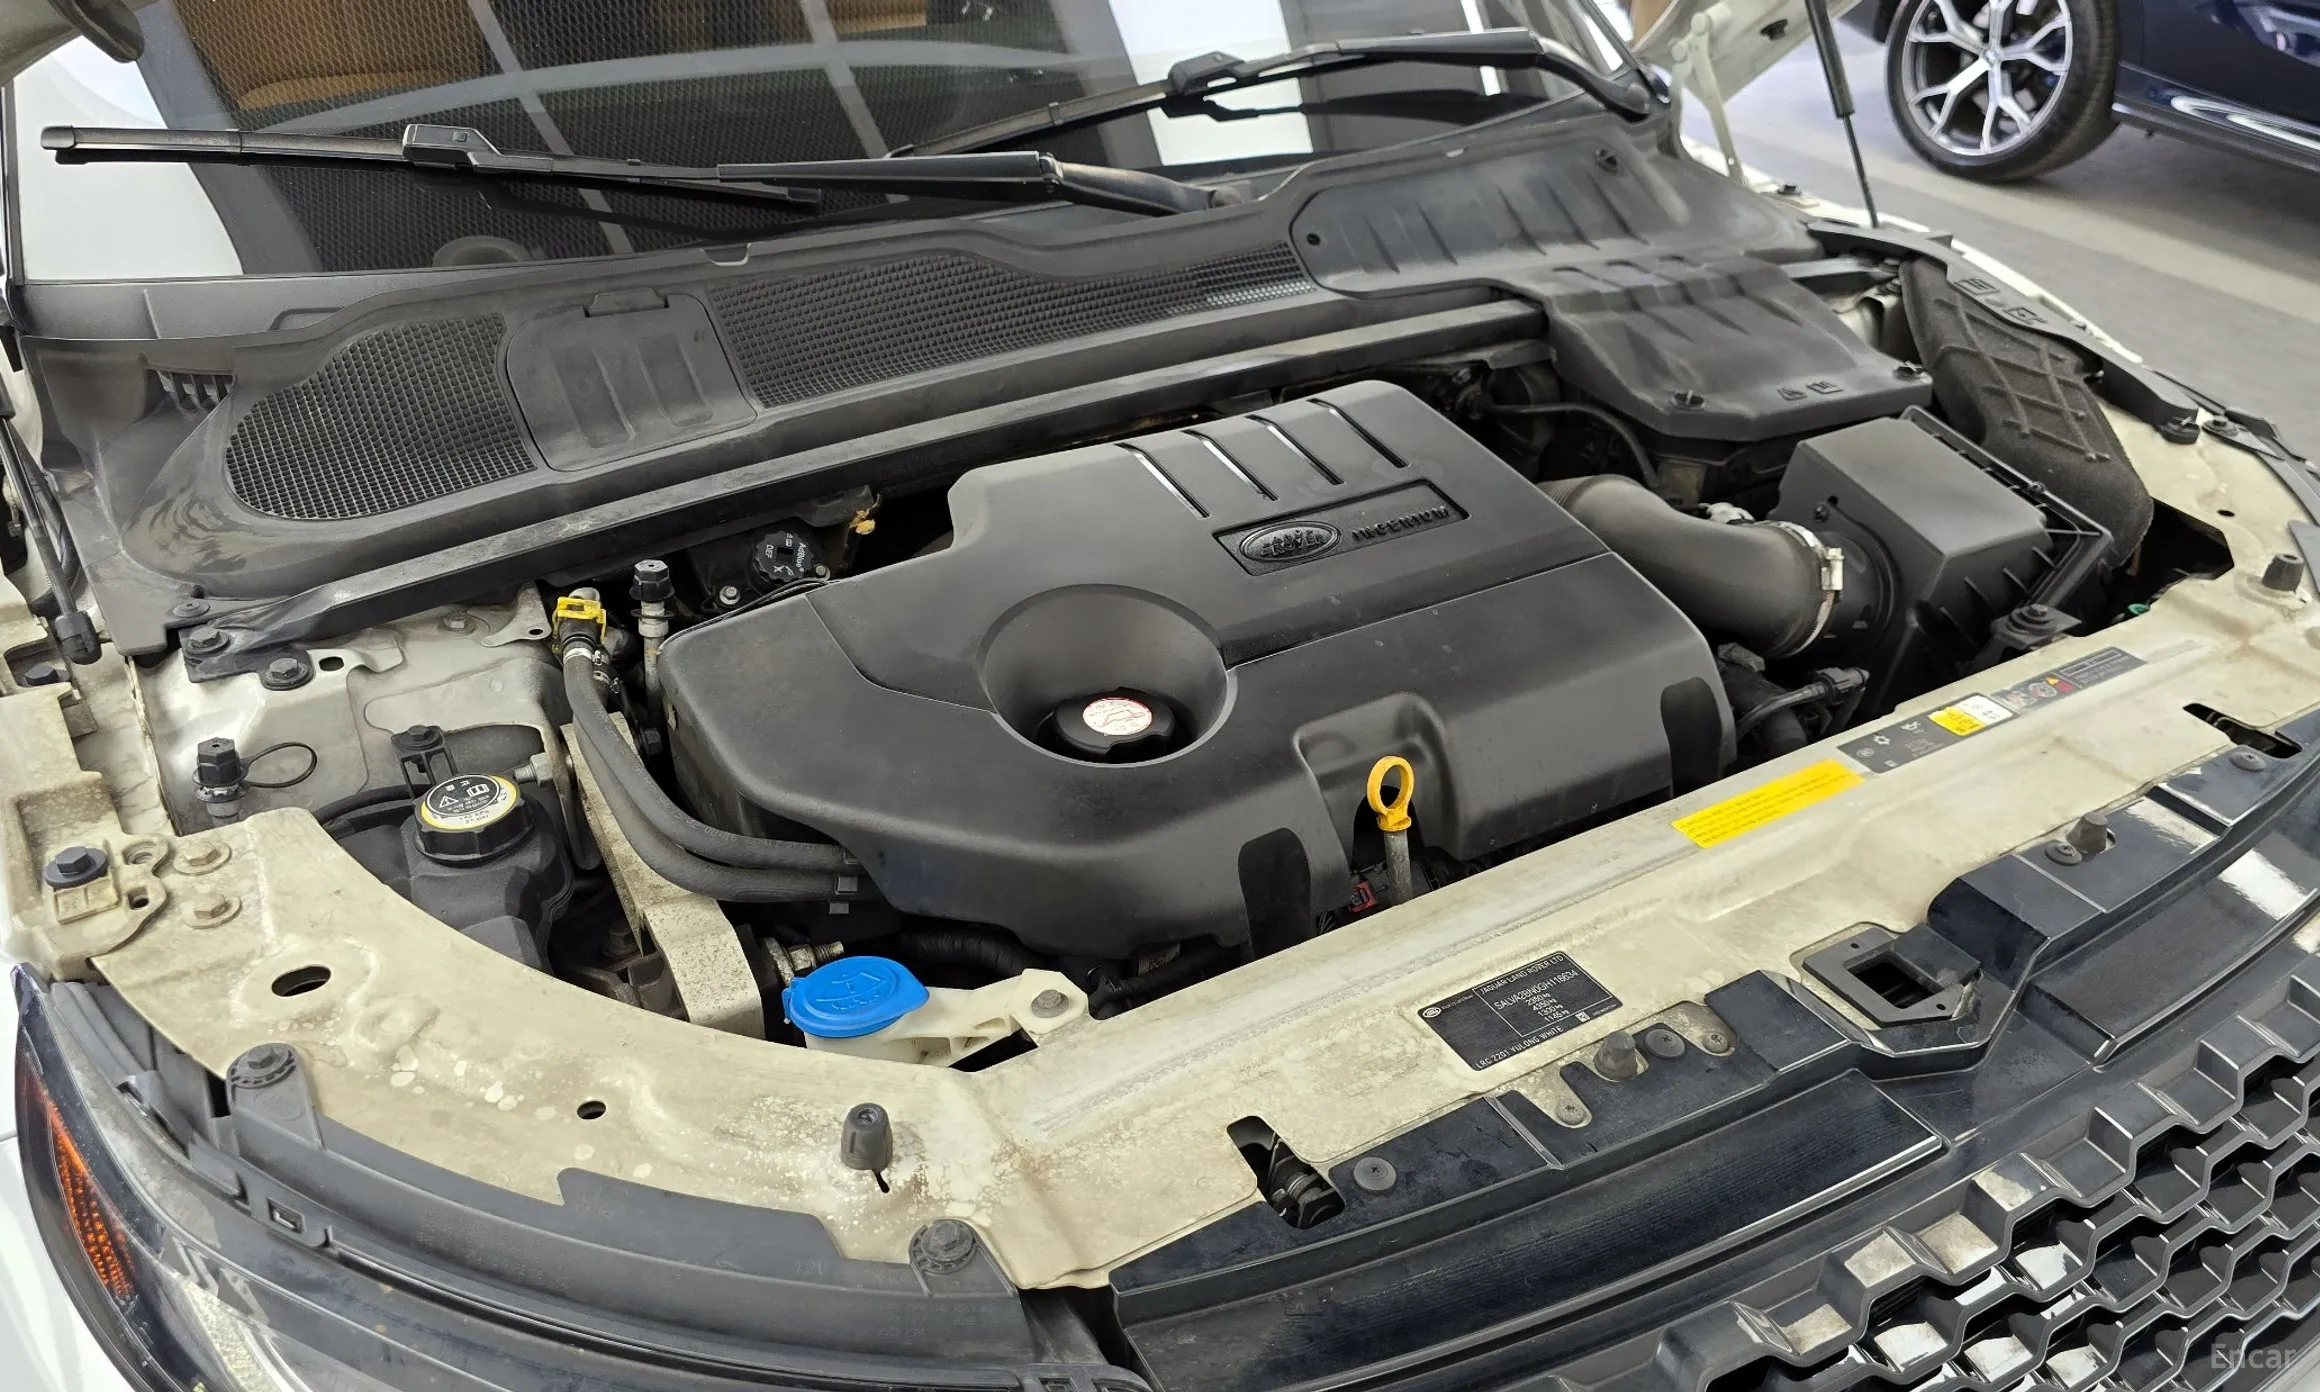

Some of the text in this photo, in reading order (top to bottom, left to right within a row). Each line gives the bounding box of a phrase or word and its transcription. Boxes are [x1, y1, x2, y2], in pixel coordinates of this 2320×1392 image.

[765, 544, 774, 559] DEF
[1480, 955, 1564, 995] JAGUAR LAND ROVER LTD
[1537, 1005, 1556, 1017] 1300
[1475, 1025, 1564, 1069] LRC 2201 YULONG WHITE
